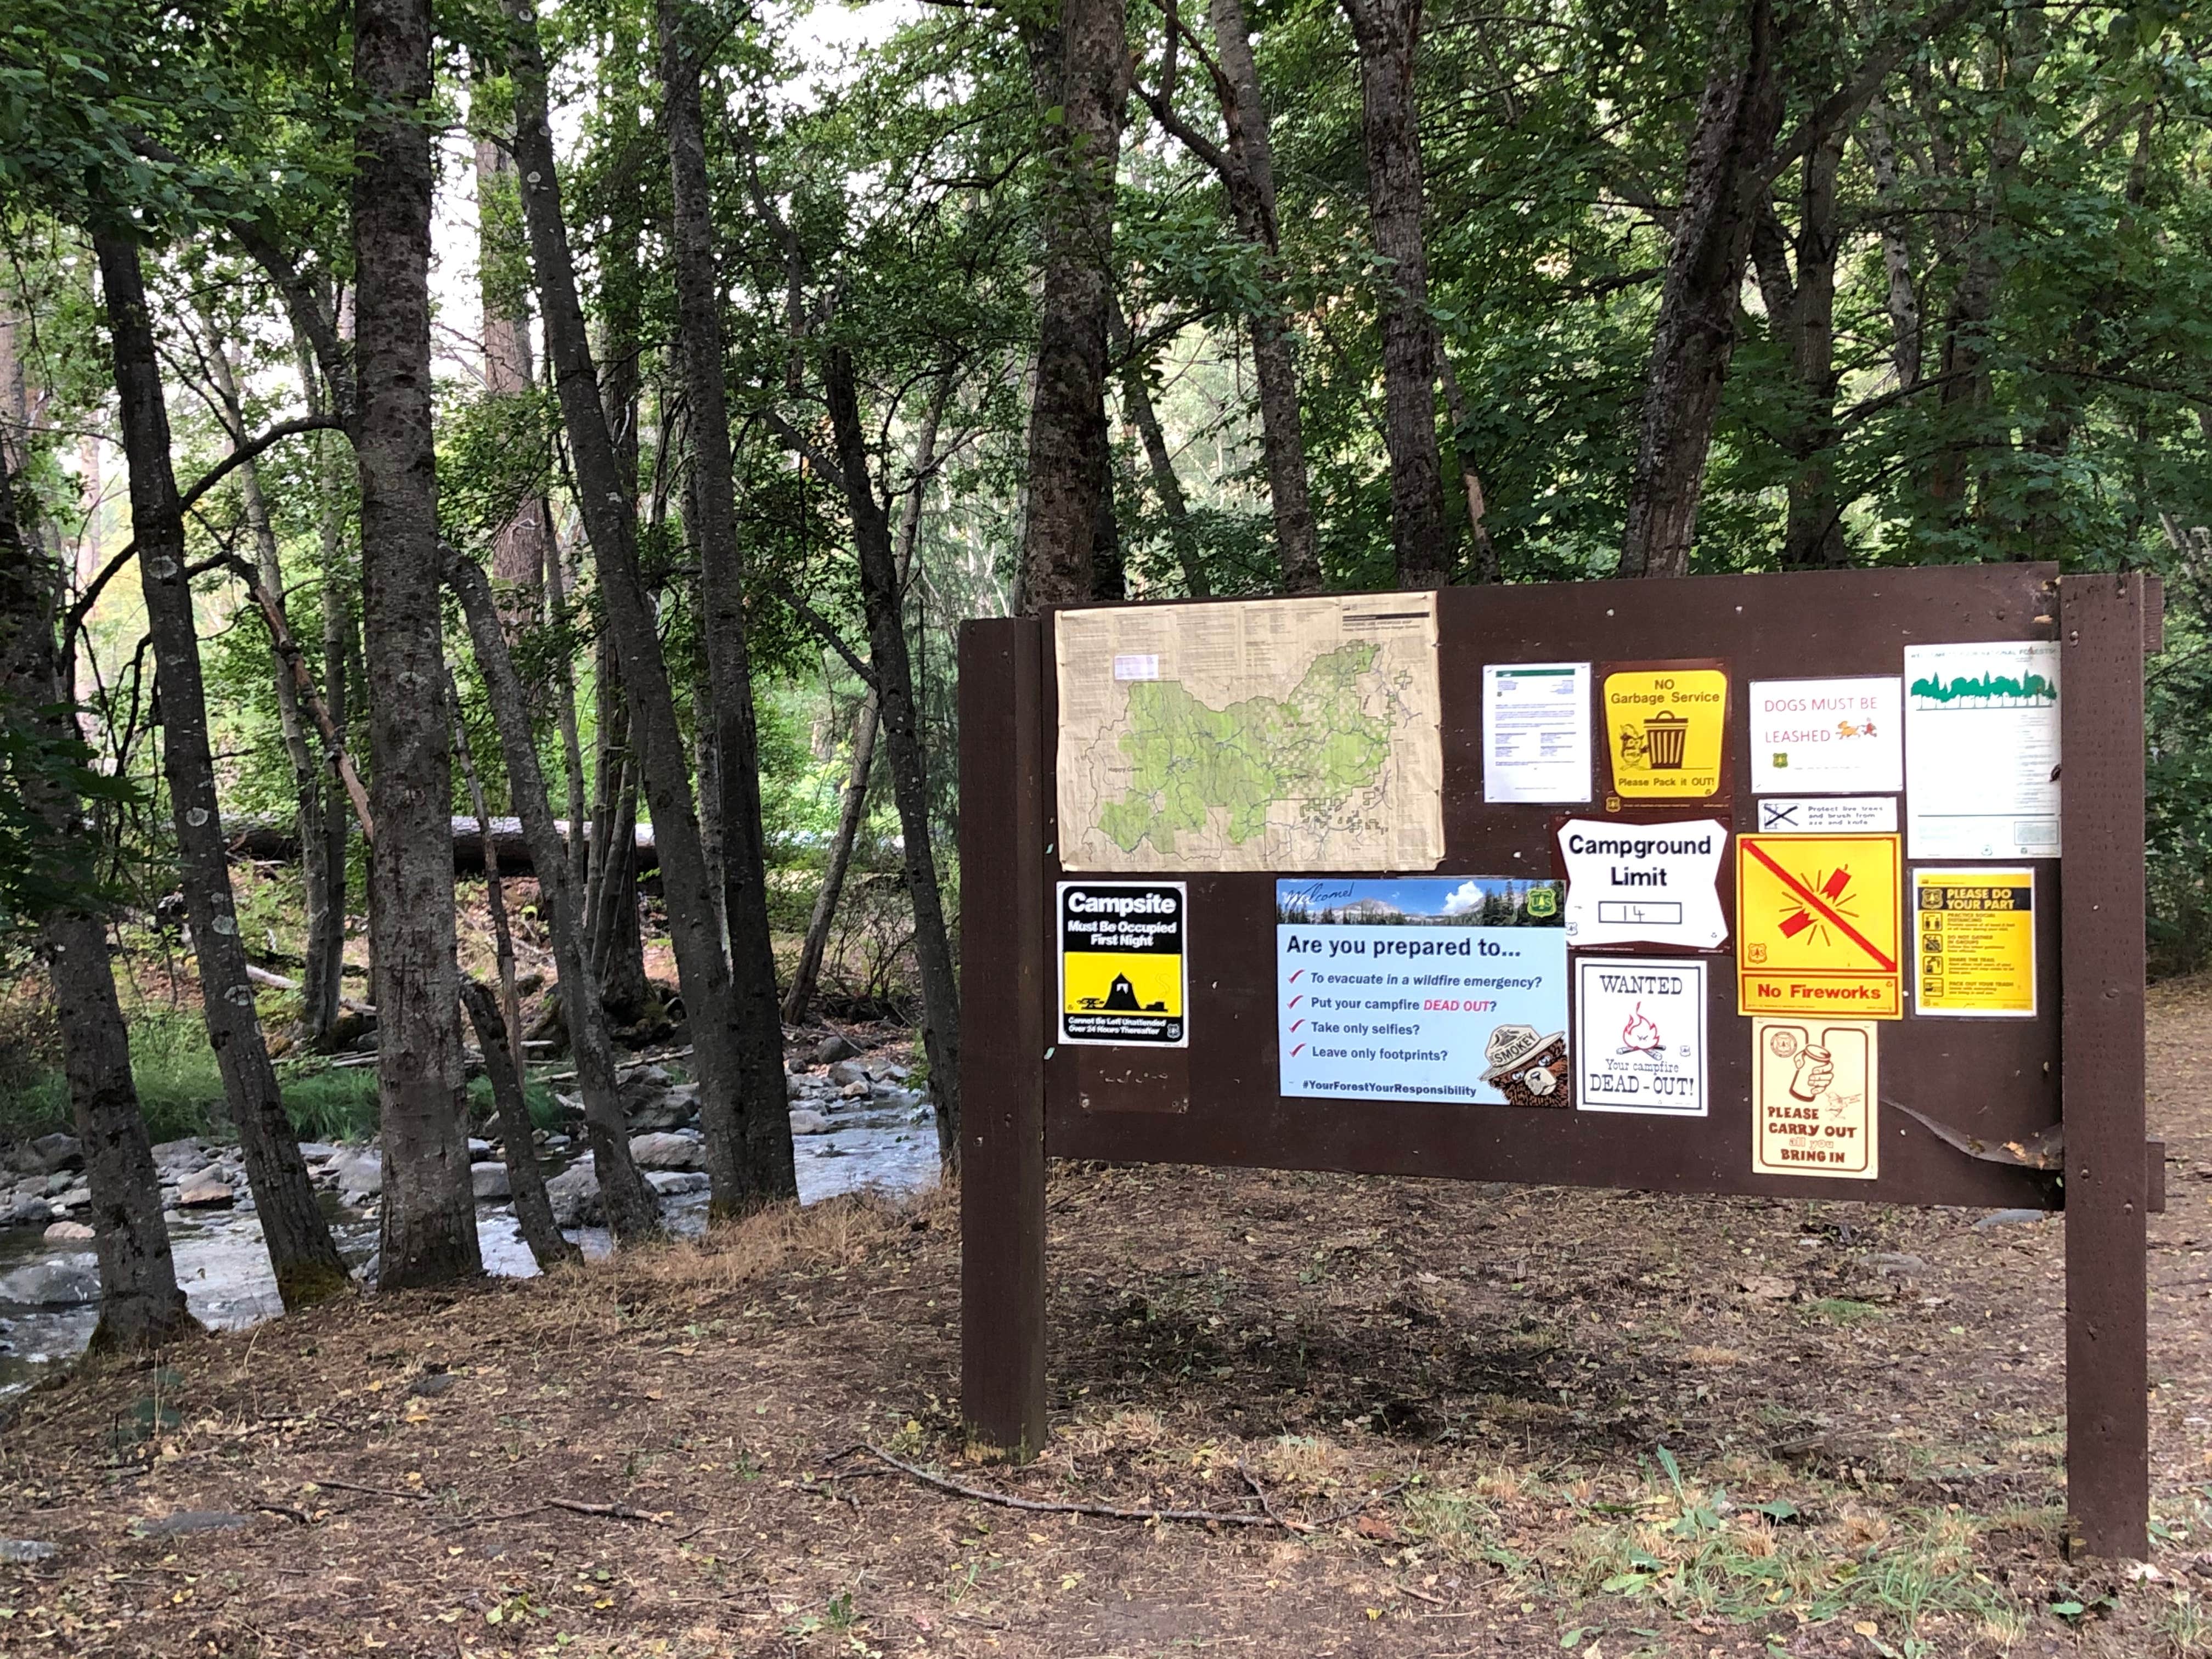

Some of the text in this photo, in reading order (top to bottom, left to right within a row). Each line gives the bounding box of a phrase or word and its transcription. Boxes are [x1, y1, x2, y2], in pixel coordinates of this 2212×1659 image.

[1654, 679, 1675, 690] NO
[1611, 691, 1720, 705] Garbage Service
[1764, 697, 1878, 713] DOGS MUST BE
[1765, 730, 1830, 743] LEASHED
[1618, 777, 1714, 787] Please Pack it OUT!
[1569, 834, 1711, 859] Campground
[1611, 867, 1667, 887] Limit
[1946, 888, 2012, 899] PLEASE DO
[1068, 891, 1177, 917] Campsite
[1946, 899, 2015, 909] YOUR PART
[1623, 905, 1645, 922] 14
[1068, 920, 1177, 934] Must Be Occupied
[1091, 933, 1154, 948] First Night
[1286, 936, 1522, 959] Are you prepared to...
[1311, 973, 1542, 989] To evacuate in a wildfire emergency?
[1600, 974, 1683, 995] WANTED
[1758, 984, 1881, 999] No Fireworks
[1311, 997, 1497, 1012] Put your campfire DEAD OUT?
[1068, 1017, 1094, 1025] Cannot
[1122, 1018, 1167, 1026] Unattended
[1311, 1022, 1420, 1035] Take only selfies?
[1121, 1026, 1161, 1035] Thereafter
[1312, 1046, 1448, 1062] Leave only footprints?
[1493, 1032, 1537, 1063] SMOKEY
[1606, 1058, 1679, 1076] Your campfire
[1302, 1080, 1477, 1097] #YourForestYourResponsibility
[1768, 1106, 1819, 1120] PLEASE
[1769, 1122, 1857, 1138] CARRY OUT
[1789, 1137, 1834, 1150] all you
[1781, 1149, 1845, 1163] BRING IN
